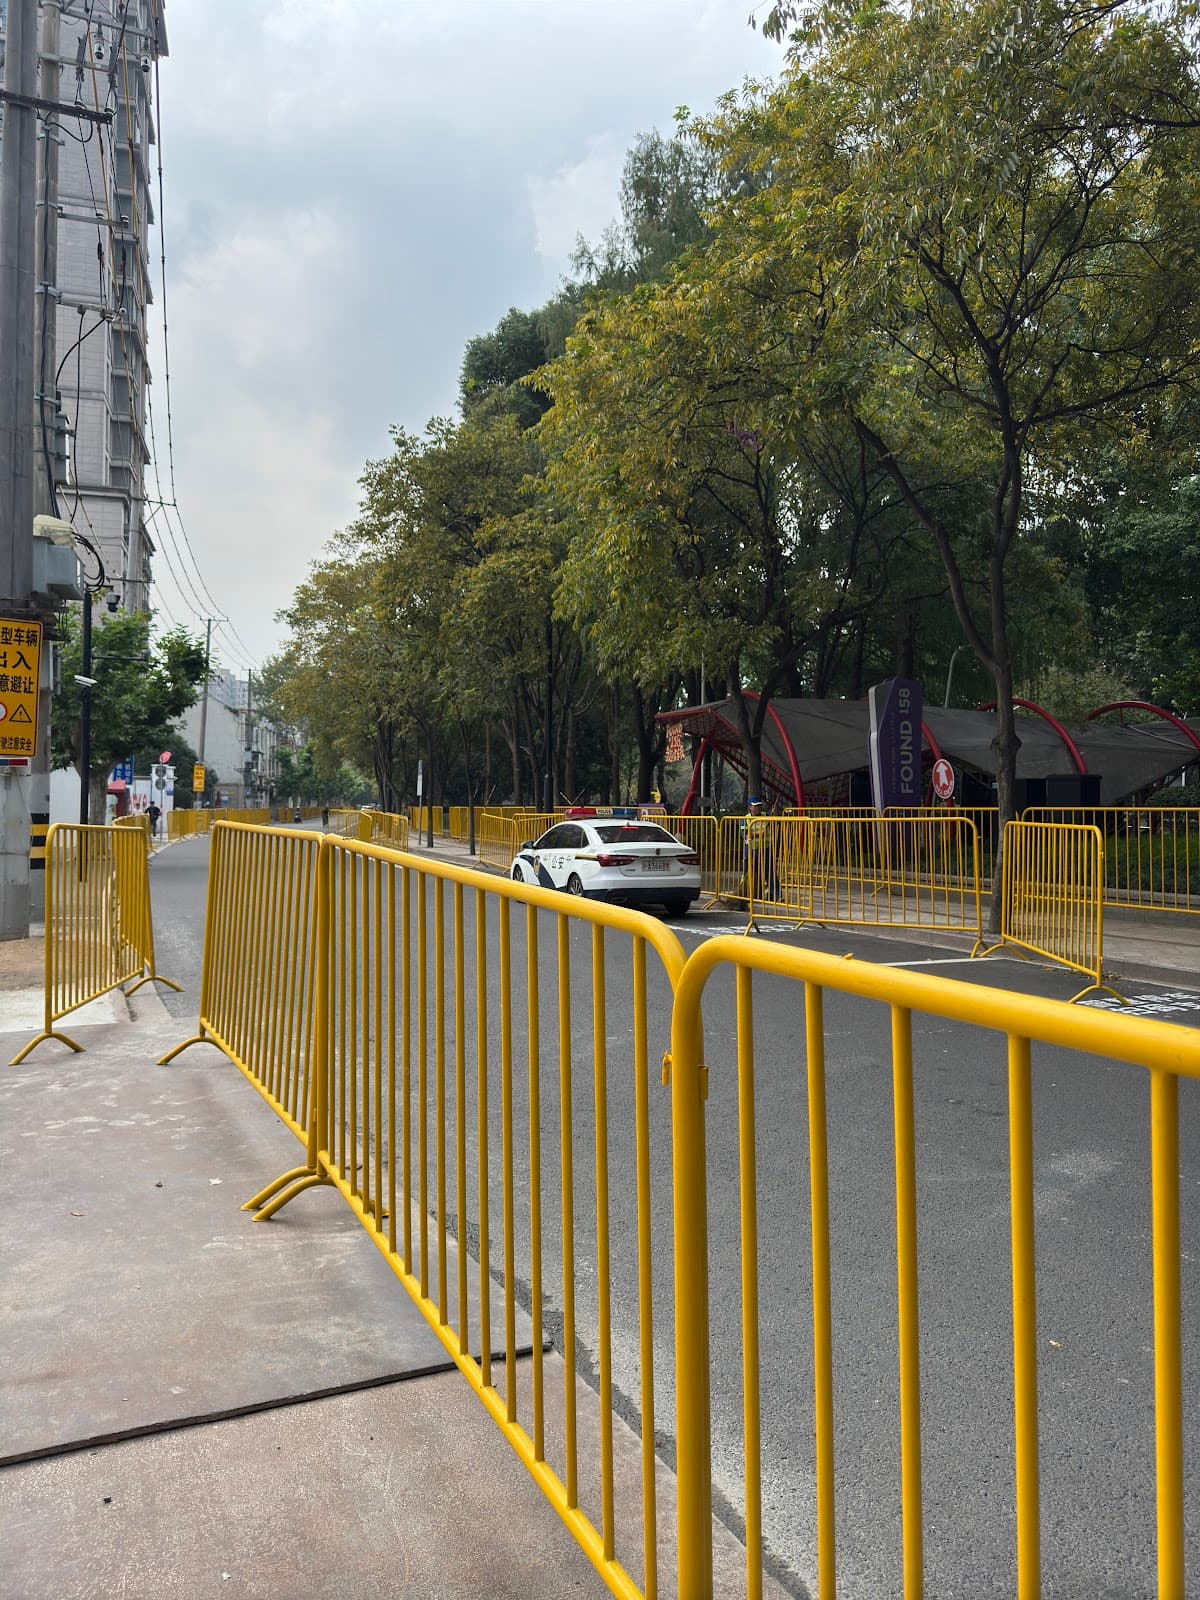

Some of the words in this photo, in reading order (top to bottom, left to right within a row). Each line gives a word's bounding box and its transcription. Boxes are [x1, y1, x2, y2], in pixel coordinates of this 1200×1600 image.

[898, 687, 911, 714] 158
[899, 720, 914, 794] FOUND
[551, 855, 565, 869] 公安
